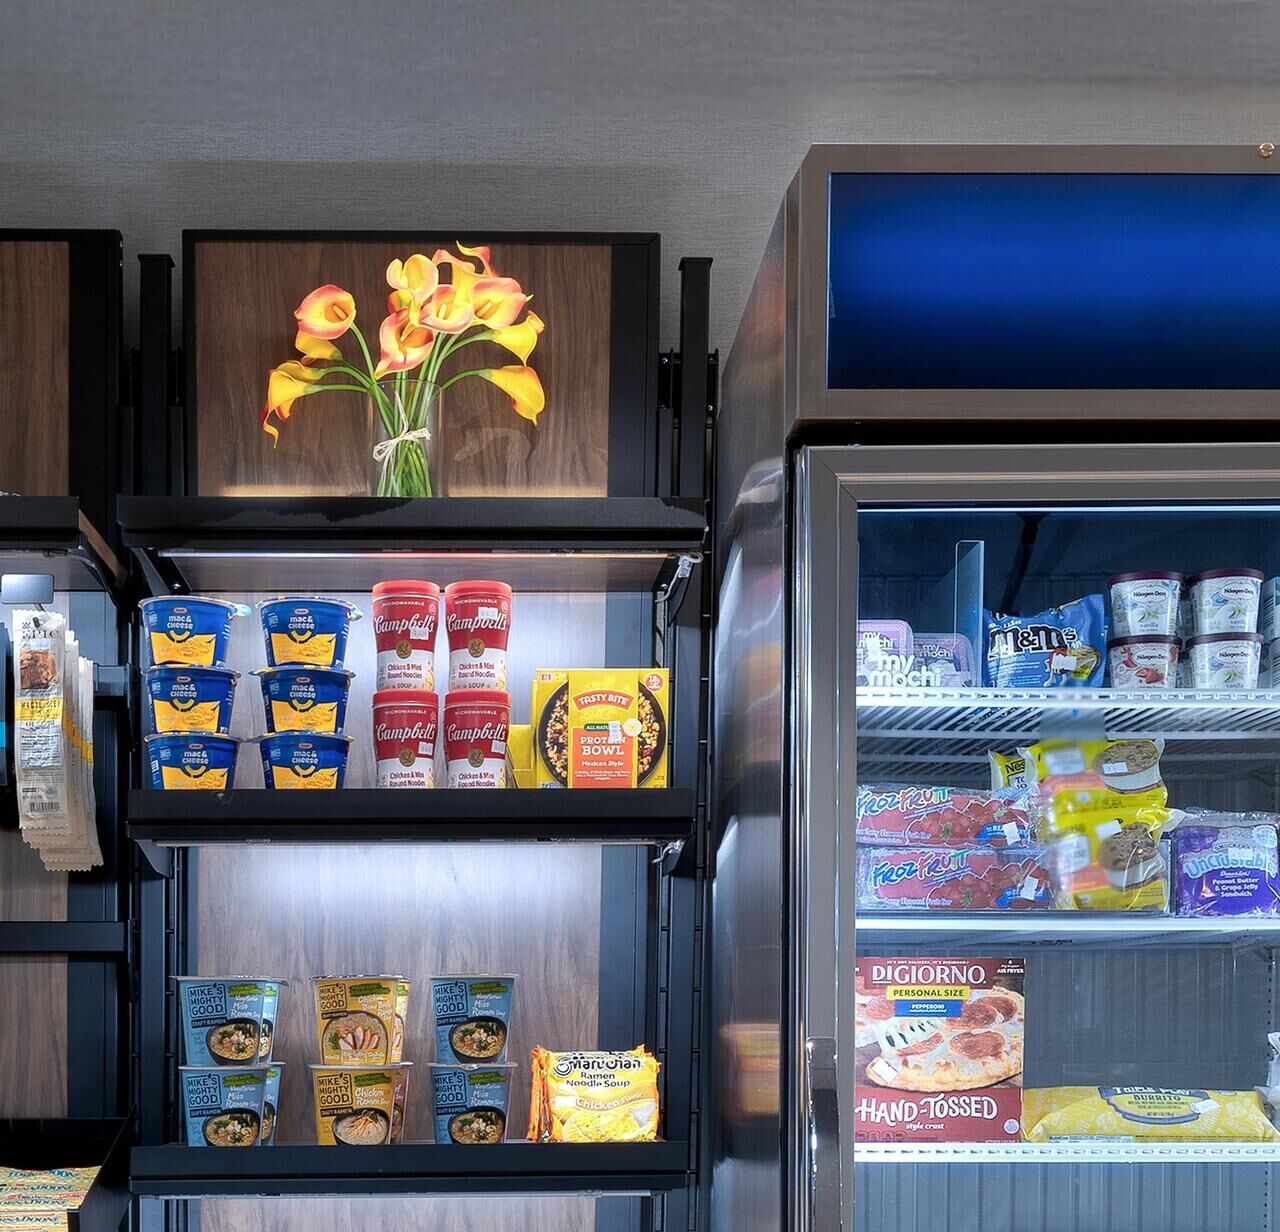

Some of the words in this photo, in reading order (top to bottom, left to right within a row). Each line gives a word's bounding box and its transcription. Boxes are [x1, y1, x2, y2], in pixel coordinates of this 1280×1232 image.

[375, 613, 435, 634] Campbell's
[578, 693, 608, 706] TASTY
[608, 694, 630, 706] BITE
[376, 721, 435, 743] Campbell's
[446, 722, 507, 743] Campbell's
[581, 745, 625, 756] BOWL
[188, 986, 223, 998] MIKE'S
[893, 988, 942, 998] PERSONAL
[945, 988, 964, 997] SIZE
[190, 996, 223, 1007] MIGHTY
[911, 1003, 945, 1011] PEPPERONI
[604, 1079, 630, 1088] Soup
[319, 1086, 350, 1095] MIGHTY
[855, 1093, 998, 1127] HAND-TOSSED
[924, 1122, 945, 1130] crust
